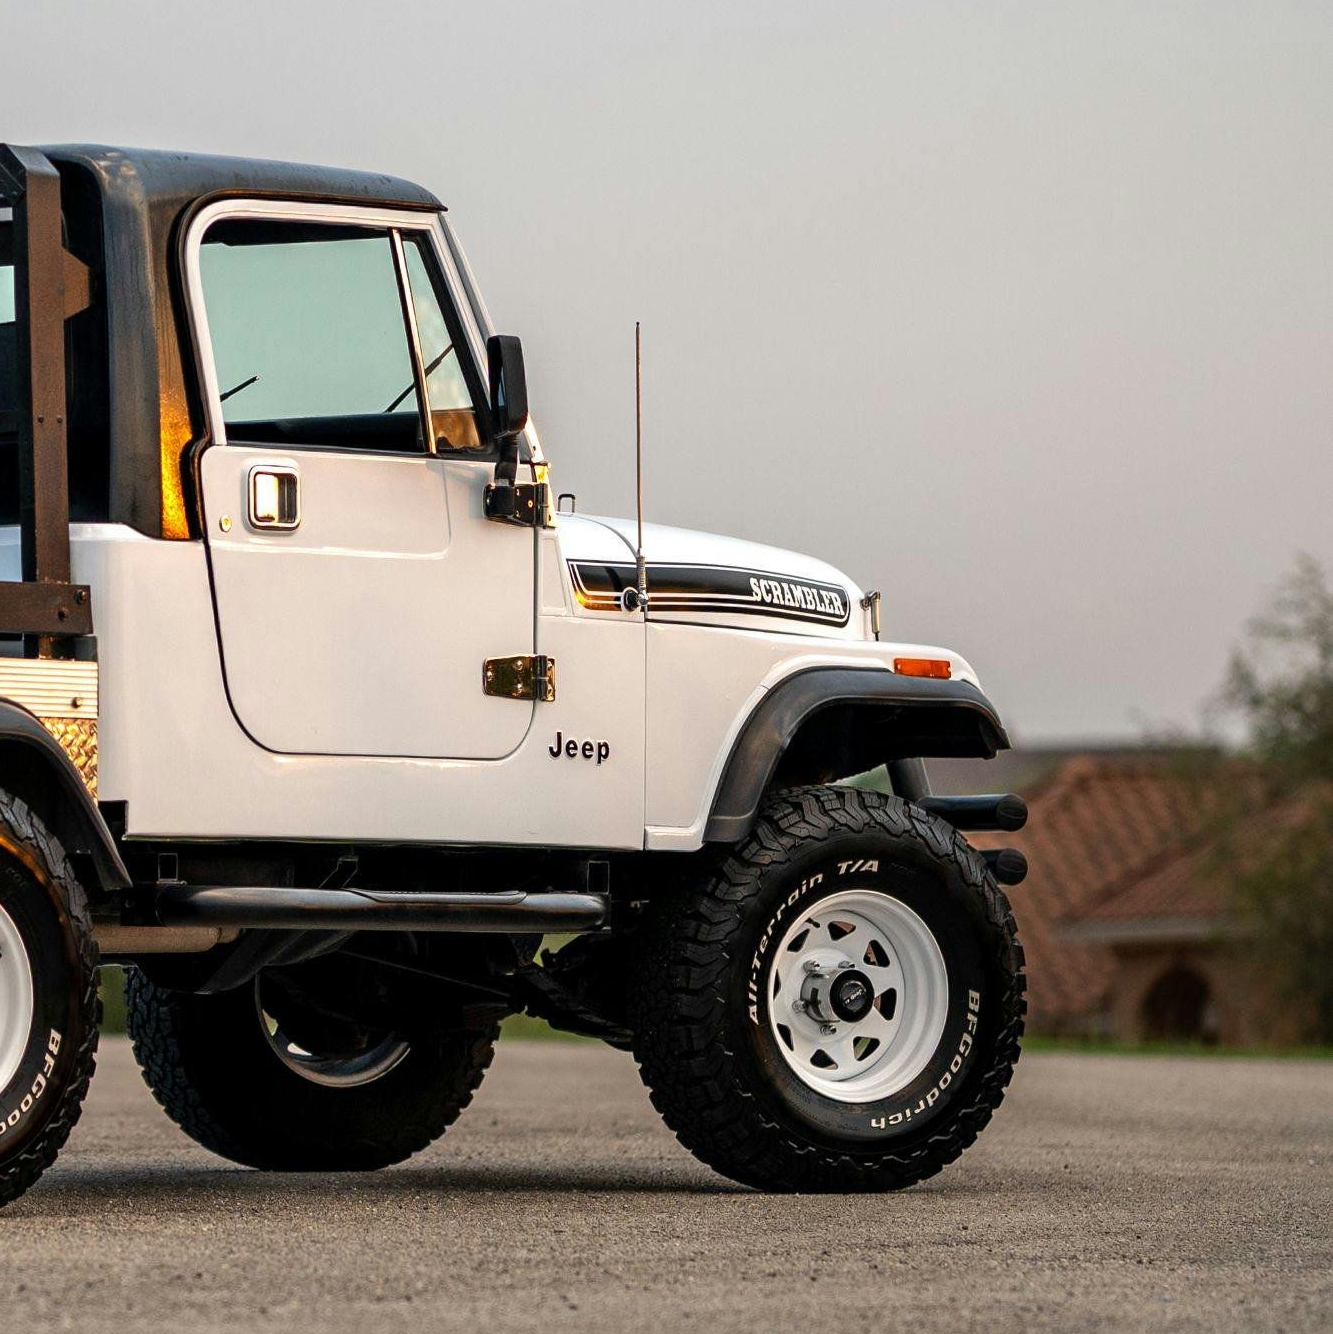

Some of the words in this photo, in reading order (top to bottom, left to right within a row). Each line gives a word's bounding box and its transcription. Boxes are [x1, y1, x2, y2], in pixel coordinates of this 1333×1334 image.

[748, 576, 846, 617] SCRAMBLER
[548, 731, 610, 764] Jeep
[749, 872, 824, 1025] All-Terrain
[837, 859, 879, 875] T/A
[870, 988, 981, 1130] BFGoodrich
